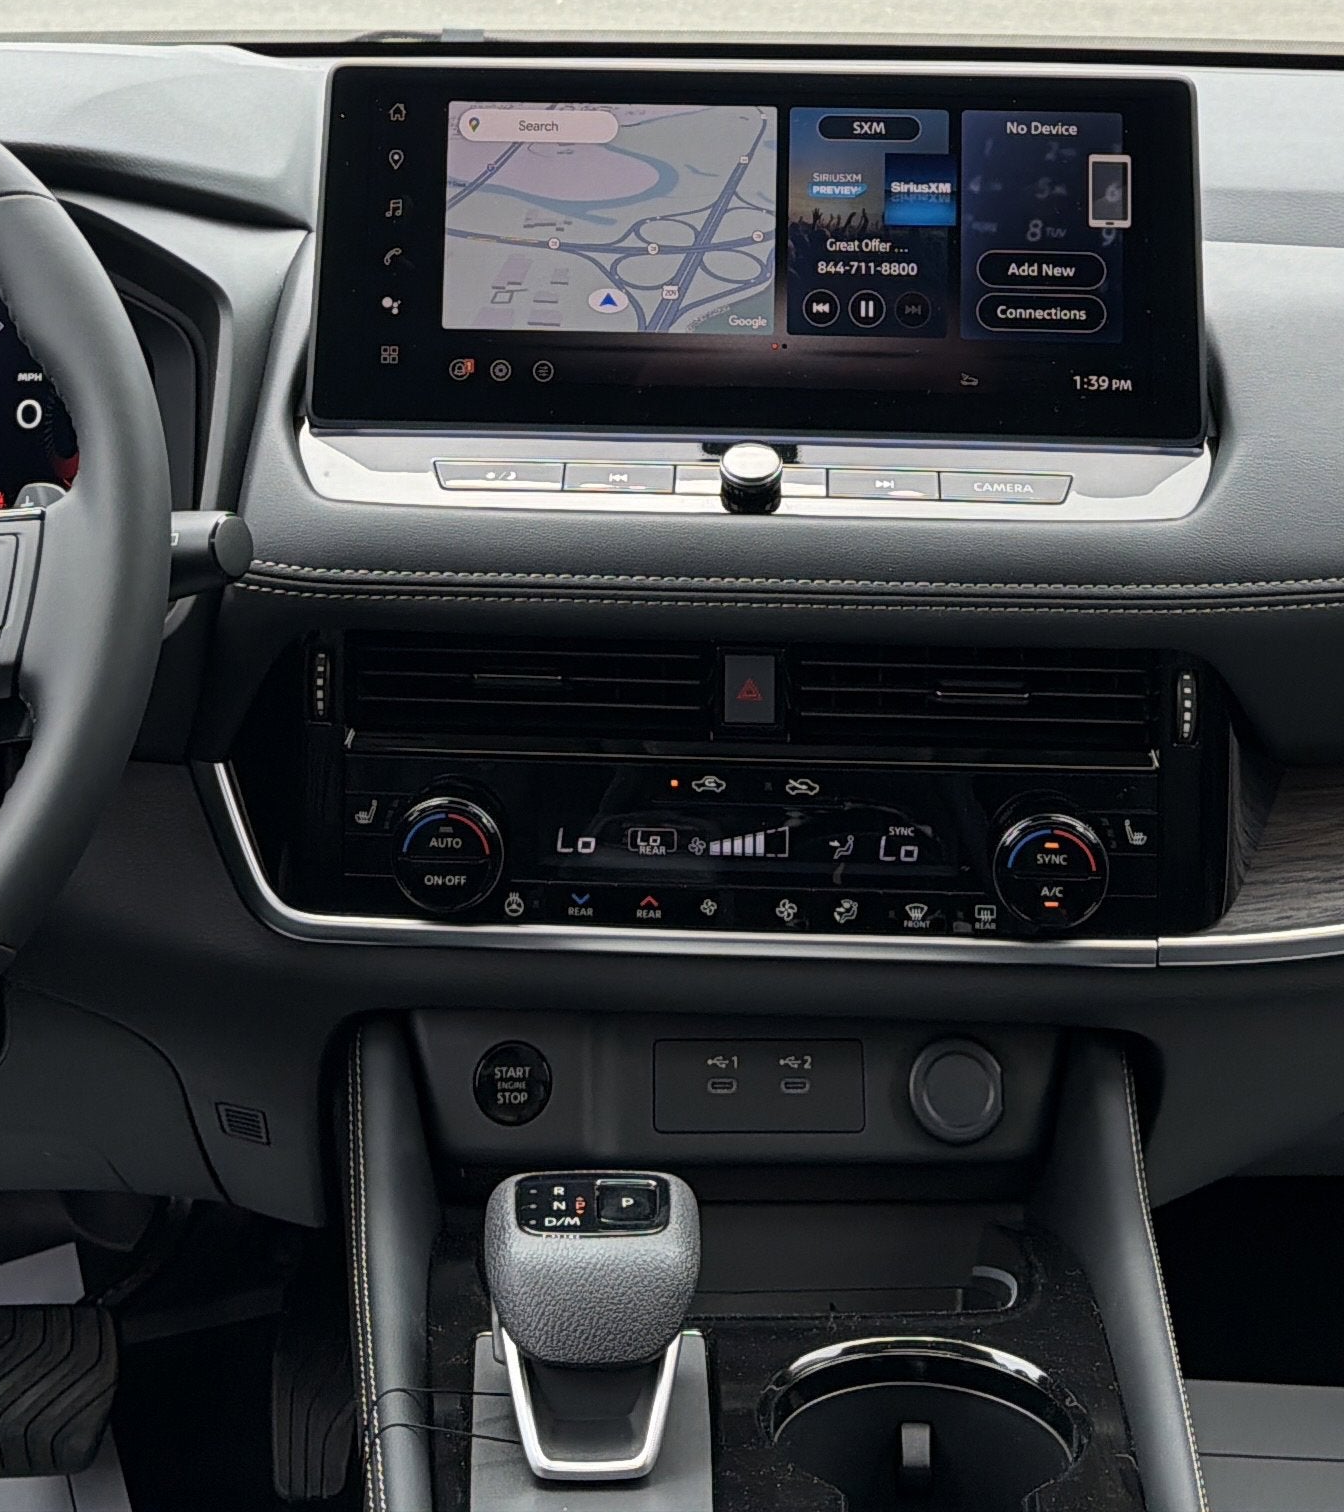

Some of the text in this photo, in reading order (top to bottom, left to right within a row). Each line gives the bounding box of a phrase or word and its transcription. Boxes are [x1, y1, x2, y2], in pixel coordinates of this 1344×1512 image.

[519, 120, 559, 133] Search
[853, 122, 885, 134] SXM
[1006, 122, 1077, 135] No Device
[812, 186, 860, 194] PREVIEW
[891, 182, 951, 193] SiriusXM
[826, 240, 858, 252] Great
[862, 240, 891, 252] Offer
[817, 262, 917, 275] 844-711-8800
[1008, 263, 1075, 277] Add New
[997, 306, 1086, 320] Connections
[729, 316, 767, 329] Google
[17, 373, 42, 381] MPH
[1073, 376, 1132, 391] 1:39 PM
[974, 482, 1034, 494] CAMERA
[888, 826, 915, 837] SYNC
[429, 837, 462, 849] AUTO
[639, 846, 666, 855] REAR
[1036, 853, 1068, 866] SYNC
[1040, 886, 1064, 898] A/C
[568, 907, 594, 917] REAR
[636, 909, 662, 919] REAR
[904, 920, 930, 929] FRONT
[974, 921, 997, 930] REAR
[731, 1055, 738, 1070] 1
[803, 1055, 812, 1070] 2
[494, 1067, 531, 1078] START
[497, 1081, 526, 1090] ENGINE
[497, 1092, 528, 1104] STOP
[554, 1187, 564, 1195] R
[553, 1201, 566, 1210] N
[622, 1198, 634, 1207] P
[545, 1217, 581, 1226] D/M
